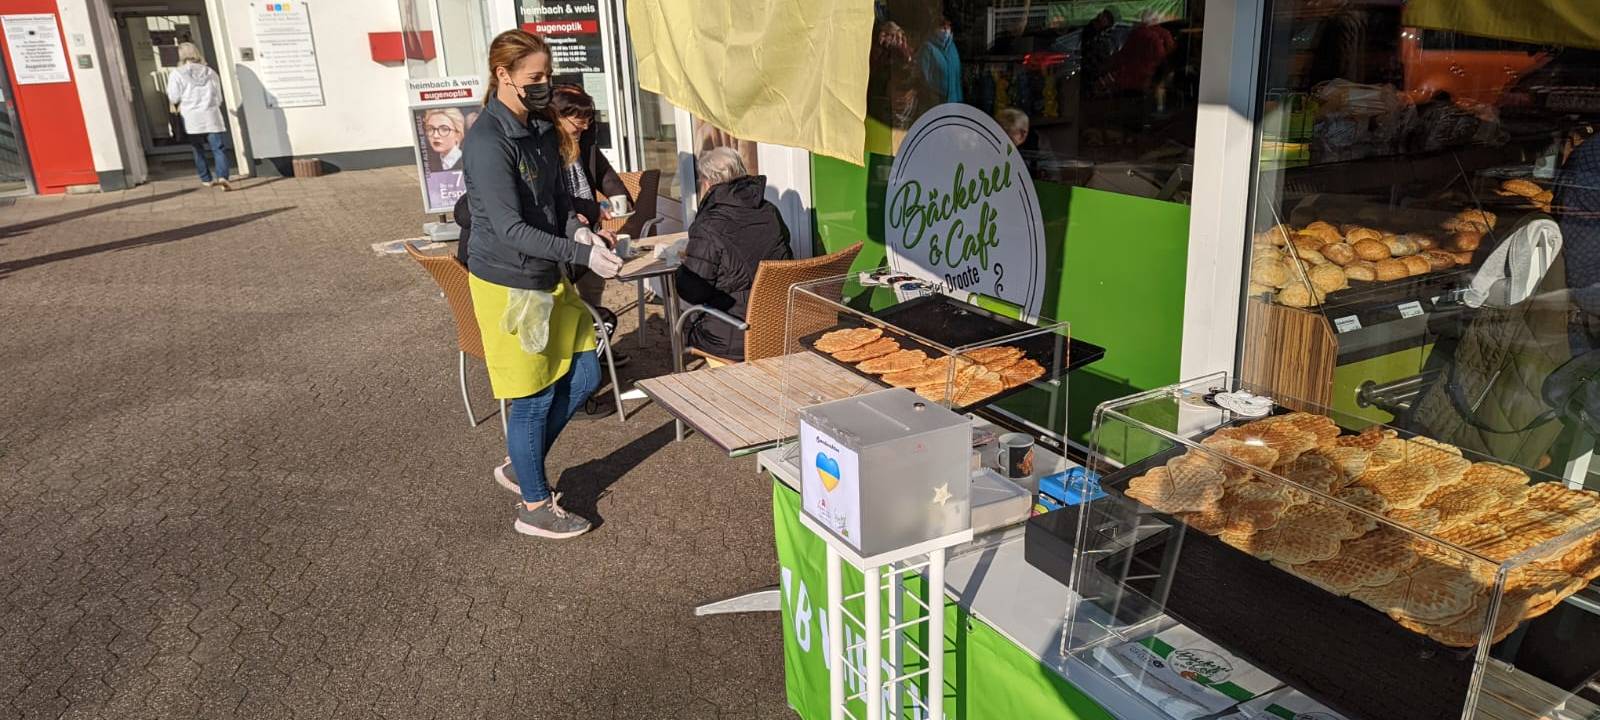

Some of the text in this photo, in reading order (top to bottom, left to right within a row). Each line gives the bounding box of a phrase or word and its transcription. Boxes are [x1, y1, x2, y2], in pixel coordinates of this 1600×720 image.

[520, 3, 596, 15] heimbach & weis
[536, 22, 583, 34] augenoptik
[409, 77, 479, 90] heimbach & weis
[424, 89, 468, 99] augenoptik
[889, 144, 1012, 249] Bäckerei
[929, 201, 1000, 271] & Café
[945, 266, 980, 293] Droote
